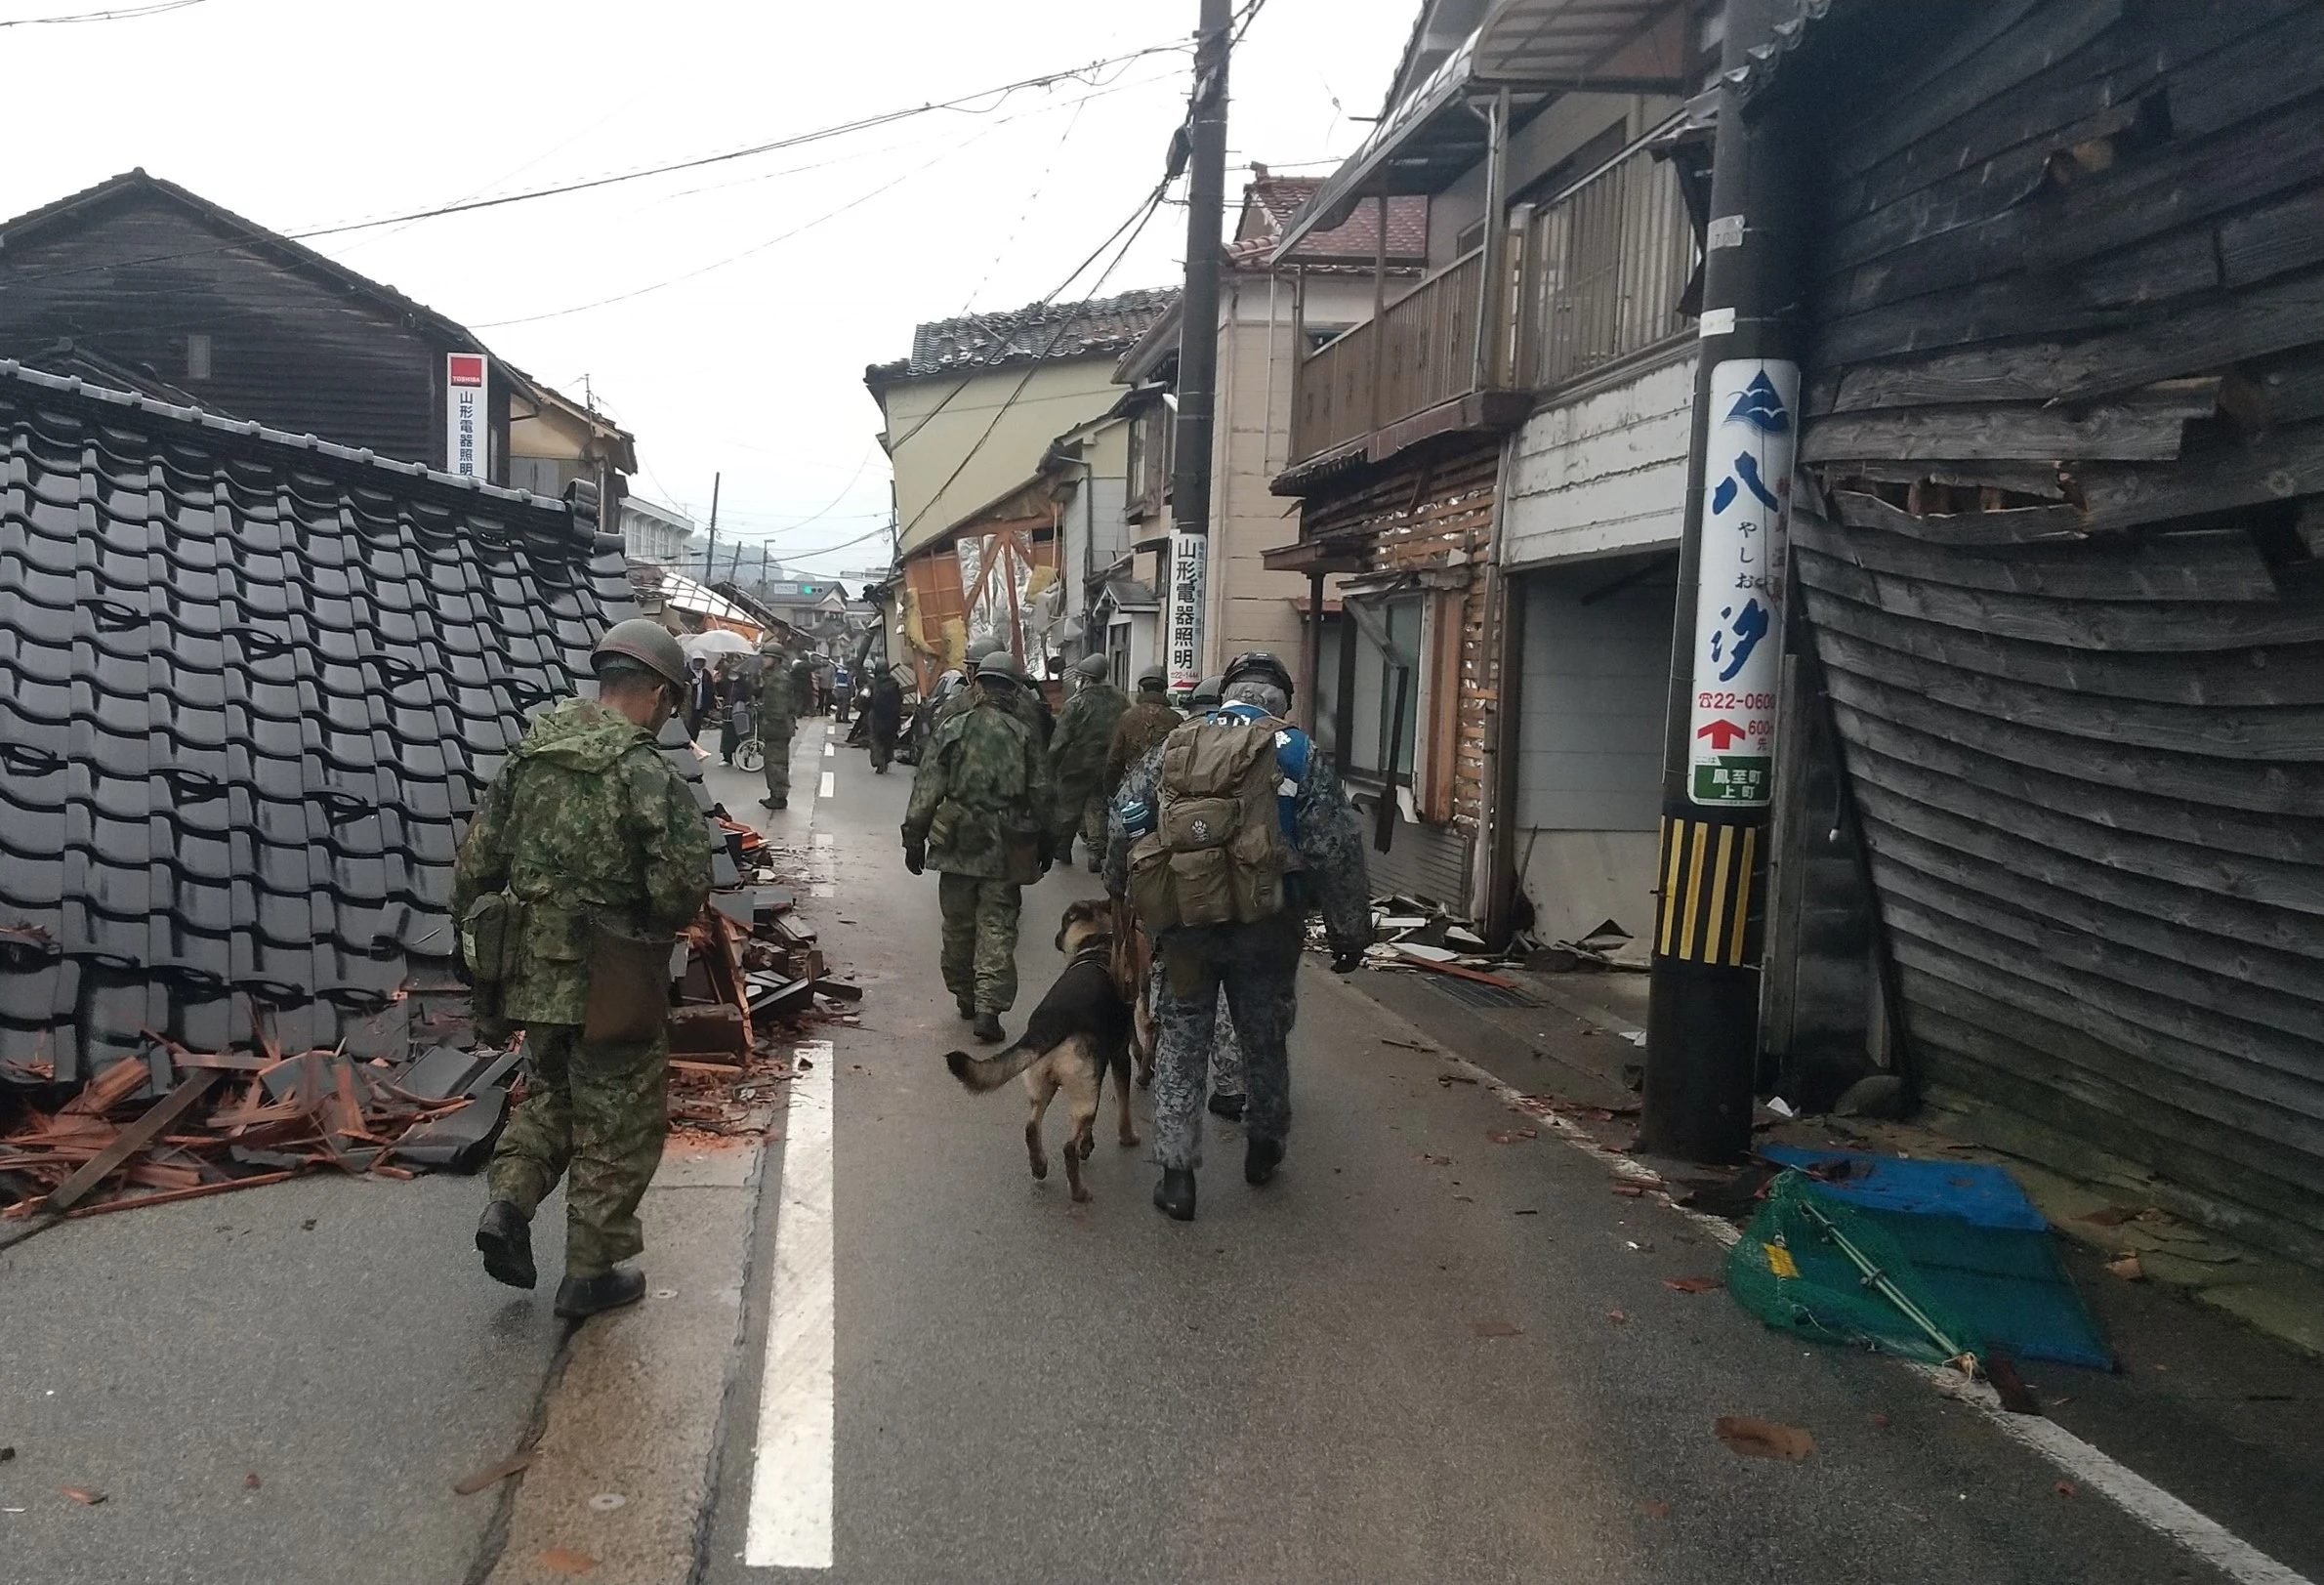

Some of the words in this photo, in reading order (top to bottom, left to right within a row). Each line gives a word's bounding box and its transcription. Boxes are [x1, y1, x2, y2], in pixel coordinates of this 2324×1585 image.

[452, 375, 481, 384] TOSHIBA
[459, 391, 474, 476] 山形電器照明
[1712, 450, 1779, 516] 八
[1734, 521, 1758, 589] やしお
[1174, 538, 1197, 670] 山形電器照明
[1710, 598, 1770, 683] 汐
